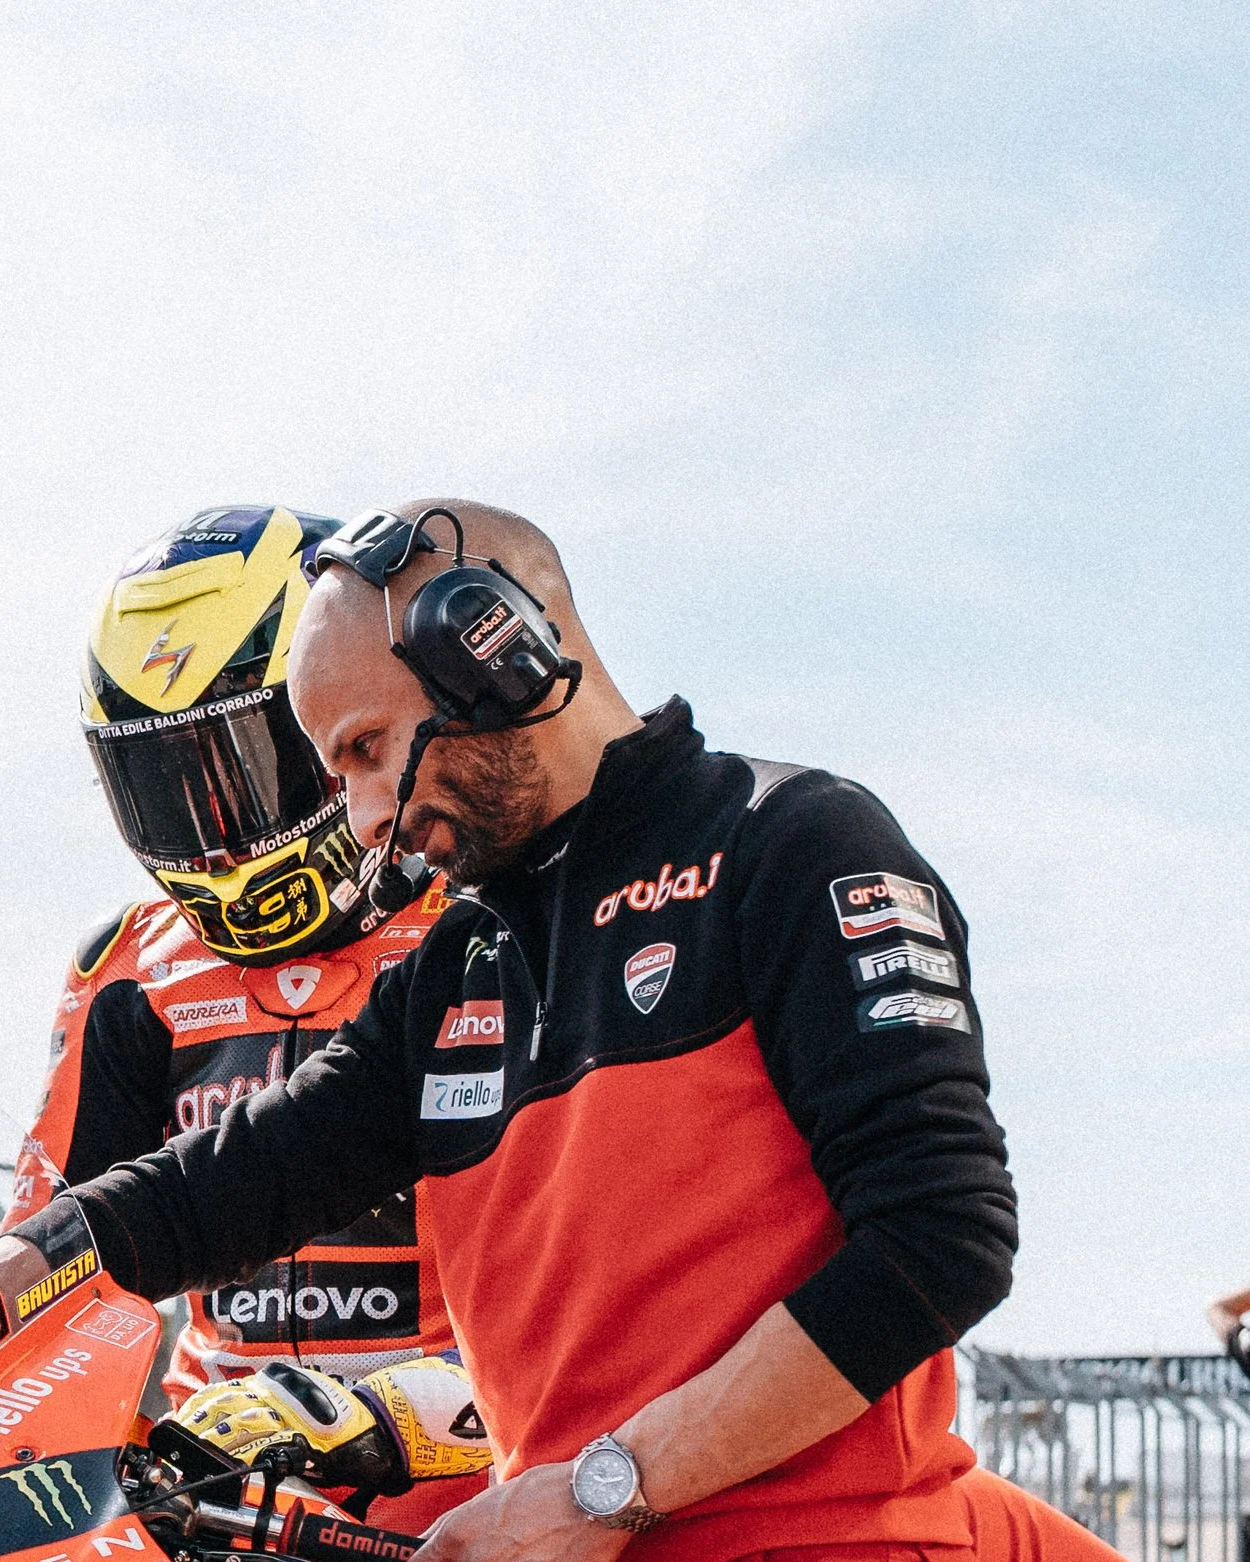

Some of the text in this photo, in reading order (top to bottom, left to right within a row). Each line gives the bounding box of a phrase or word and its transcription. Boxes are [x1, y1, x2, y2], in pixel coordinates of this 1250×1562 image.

[122, 719, 153, 736] EDILE
[154, 707, 206, 731] BALDINI
[209, 688, 274, 717] CORRADO
[629, 950, 671, 973] DUCATI
[857, 945, 950, 982] PIRELLI
[451, 1081, 491, 1108] riello
[16, 1249, 97, 1319] BAUTISTA
[212, 1282, 399, 1324] Lenovo
[39, 1347, 93, 1383] ups
